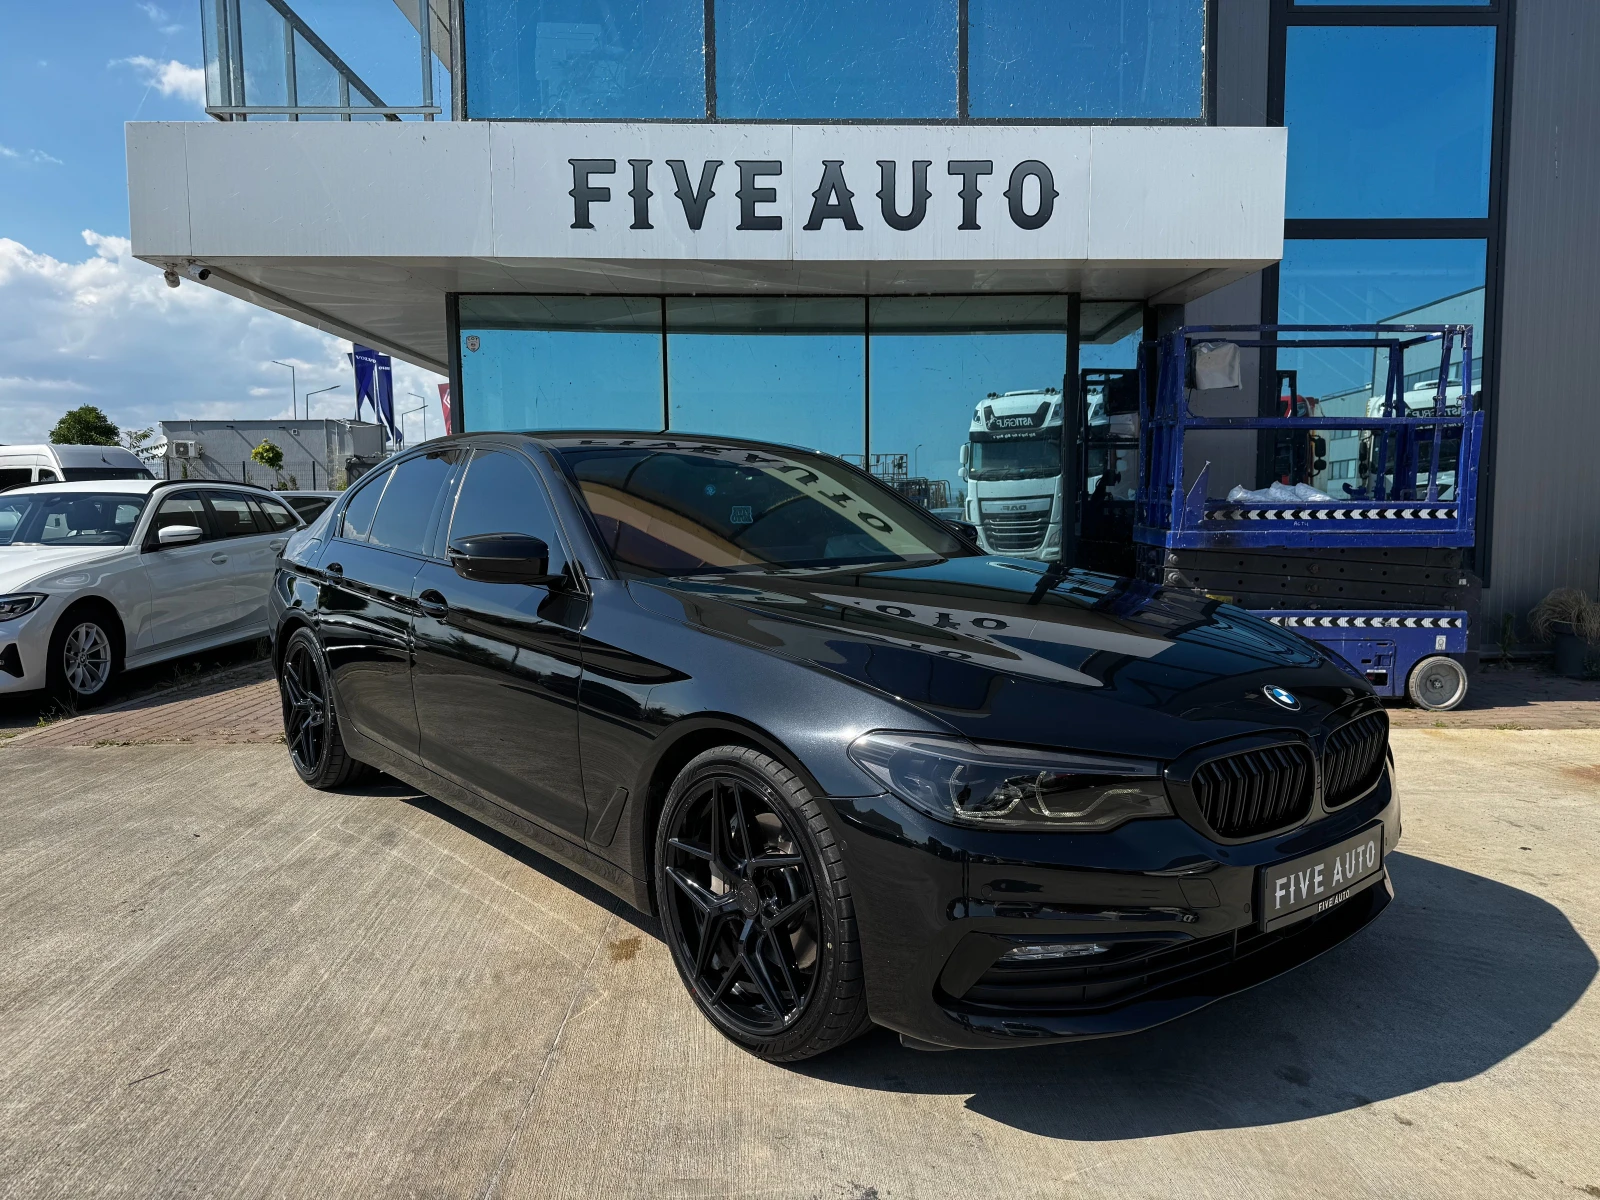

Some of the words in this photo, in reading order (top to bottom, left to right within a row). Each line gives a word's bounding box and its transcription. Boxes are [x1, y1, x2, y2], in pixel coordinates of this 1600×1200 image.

[355, 355, 377, 364] VOLVO
[1274, 862, 1325, 910] FIVE
[1331, 840, 1376, 887] AUTO
[1317, 897, 1334, 912] FIVE
[1334, 889, 1350, 904] AUTO
